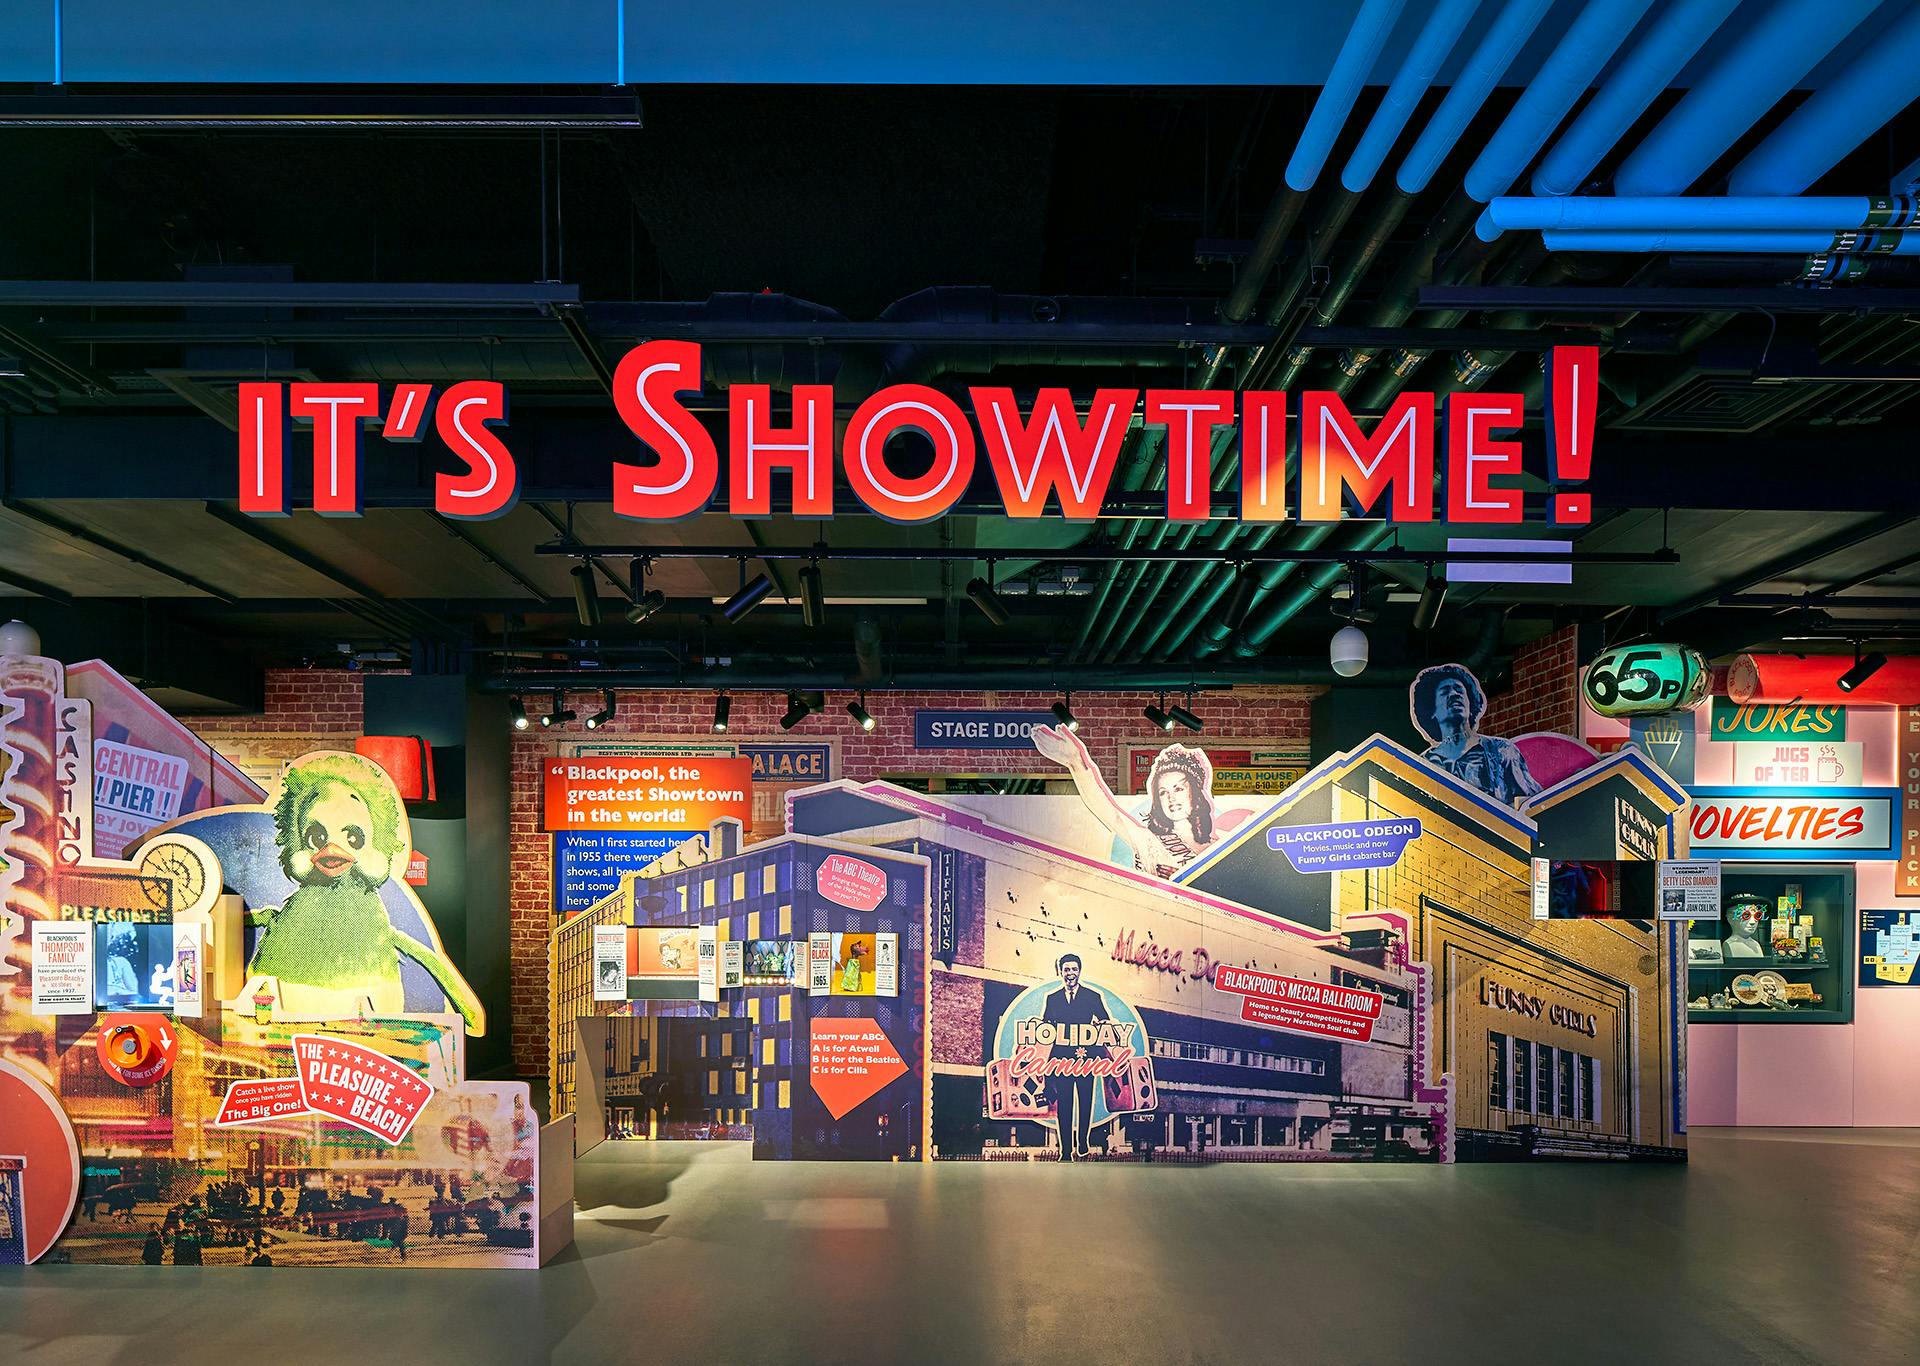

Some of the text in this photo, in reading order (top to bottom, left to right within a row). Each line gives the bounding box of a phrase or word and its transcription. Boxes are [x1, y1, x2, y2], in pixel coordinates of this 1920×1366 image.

[239, 381, 517, 519] IT’S
[931, 722, 1041, 739] STAGE DOO
[1771, 746, 1810, 762] JUGS
[95, 746, 180, 790] CENTRAL
[739, 753, 822, 774] ALACE
[669, 767, 700, 781] the
[1216, 771, 1293, 781] OPERA HOUSE
[1755, 766, 1810, 782] OF TEA
[1908, 752, 1920, 810] YOUR
[55, 706, 82, 867] CASINO
[108, 778, 155, 814] PIER
[567, 788, 744, 804] greatest Showtown
[96, 813, 150, 834] BY JOV
[567, 808, 686, 823] in the world!
[566, 837, 597, 847] When
[600, 837, 604, 847] I
[606, 837, 627, 847] first
[630, 838, 666, 847] started
[1276, 825, 1413, 843] BLACKPOOL ODEON
[1303, 843, 1332, 853] Movies,
[1333, 842, 1354, 851] music
[1356, 841, 1371, 849] and
[566, 852, 659, 862] in 1955 there were
[1297, 855, 1326, 865] Funny
[1328, 853, 1351, 862] Girls
[1353, 852, 1381, 860] cabaret
[1907, 829, 1920, 887] PICK
[566, 866, 614, 878] shows, all
[831, 859, 880, 887] The ABC Theatre
[566, 881, 615, 891] and some
[1662, 876, 1679, 887] BETTY
[566, 896, 589, 905] here
[942, 853, 952, 950] TIFFANYS
[40, 941, 85, 953] THOMPSON
[812, 949, 829, 960] BLACK
[1111, 927, 1186, 976] Mecca
[48, 952, 76, 963] FAMILY
[1224, 971, 1287, 997] BLACKPOOL’S
[1287, 983, 1320, 1005] MECCA
[1322, 989, 1374, 1013] BALLROOM
[1249, 1001, 1270, 1011] Home
[1271, 1004, 1279, 1012] to
[1280, 1006, 1304, 1017] beauty
[1305, 1010, 1351, 1026] competitions
[1352, 1020, 1366, 1028] and
[1257, 1010, 1293, 1024] legendary
[1293, 1016, 1326, 1029] Northern
[1326, 1023, 1342, 1032] Soul
[1342, 1025, 1359, 1035] club.
[812, 1033, 885, 1043] Learn your ABCs
[1017, 1020, 1134, 1047] HOLIDAY
[299, 1043, 324, 1062] THE
[812, 1045, 880, 1053] A is for Atwell
[812, 1055, 820, 1063] B
[831, 1055, 846, 1063] for
[847, 1055, 864, 1064] the
[865, 1056, 900, 1064] Beatles
[1010, 1046, 1132, 1077] Carnival
[812, 1066, 869, 1075] C is for Cilla
[235, 1086, 256, 1097] Catch
[263, 1083, 275, 1093] live
[276, 1082, 296, 1092] show
[308, 1060, 396, 1106] PLEASURE
[259, 1093, 273, 1101] have
[274, 1090, 293, 1099] ridden
[225, 1098, 301, 1121] The Big One!
[349, 1093, 407, 1135] BEACH
